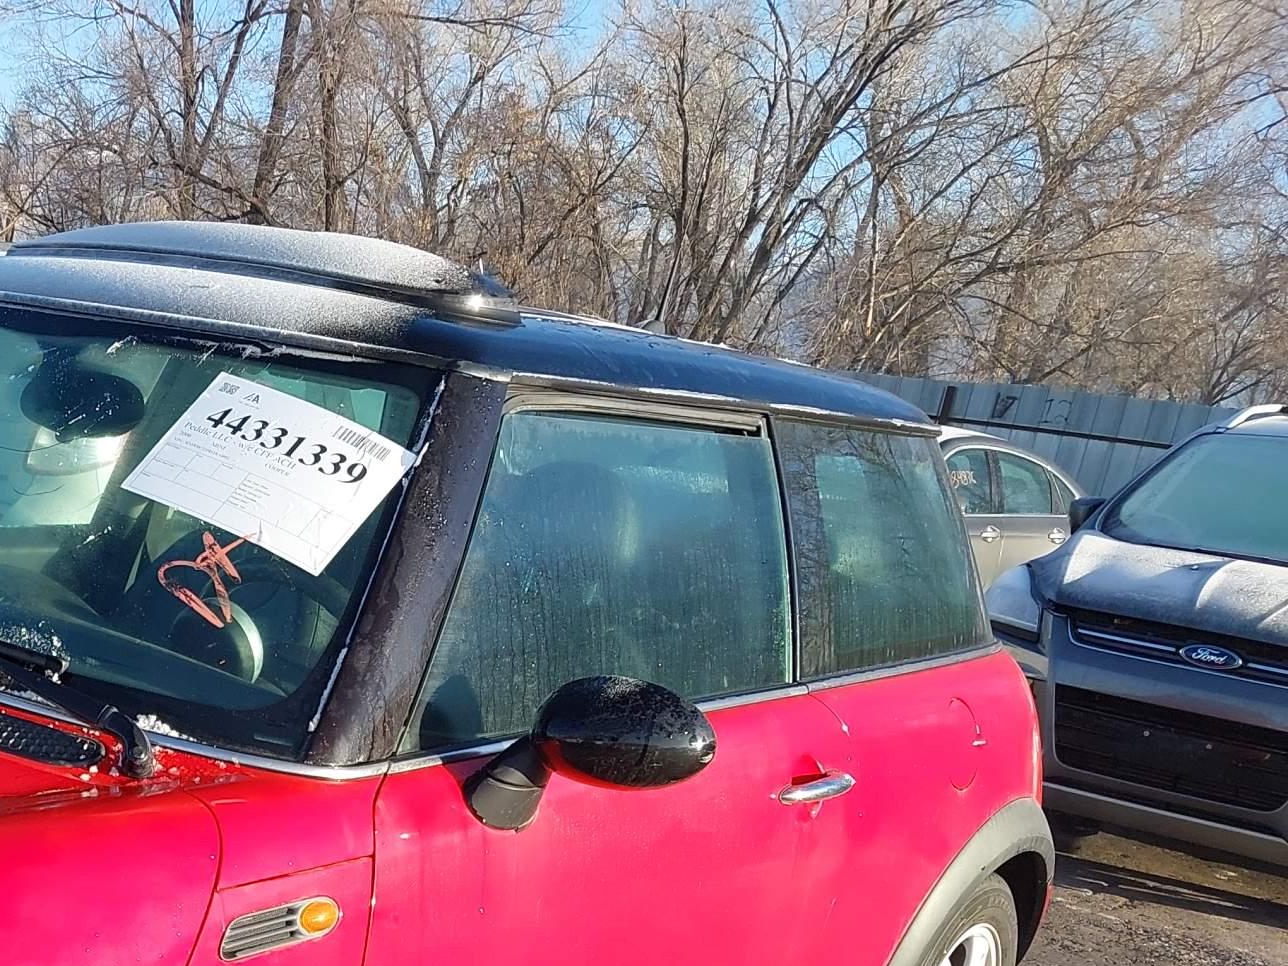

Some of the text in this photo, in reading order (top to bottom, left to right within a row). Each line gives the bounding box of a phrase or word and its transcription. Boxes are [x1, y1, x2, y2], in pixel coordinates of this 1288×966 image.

[206, 408, 367, 483] 44331339
[212, 431, 233, 443] LLC
[1191, 647, 1229, 665] Ford
